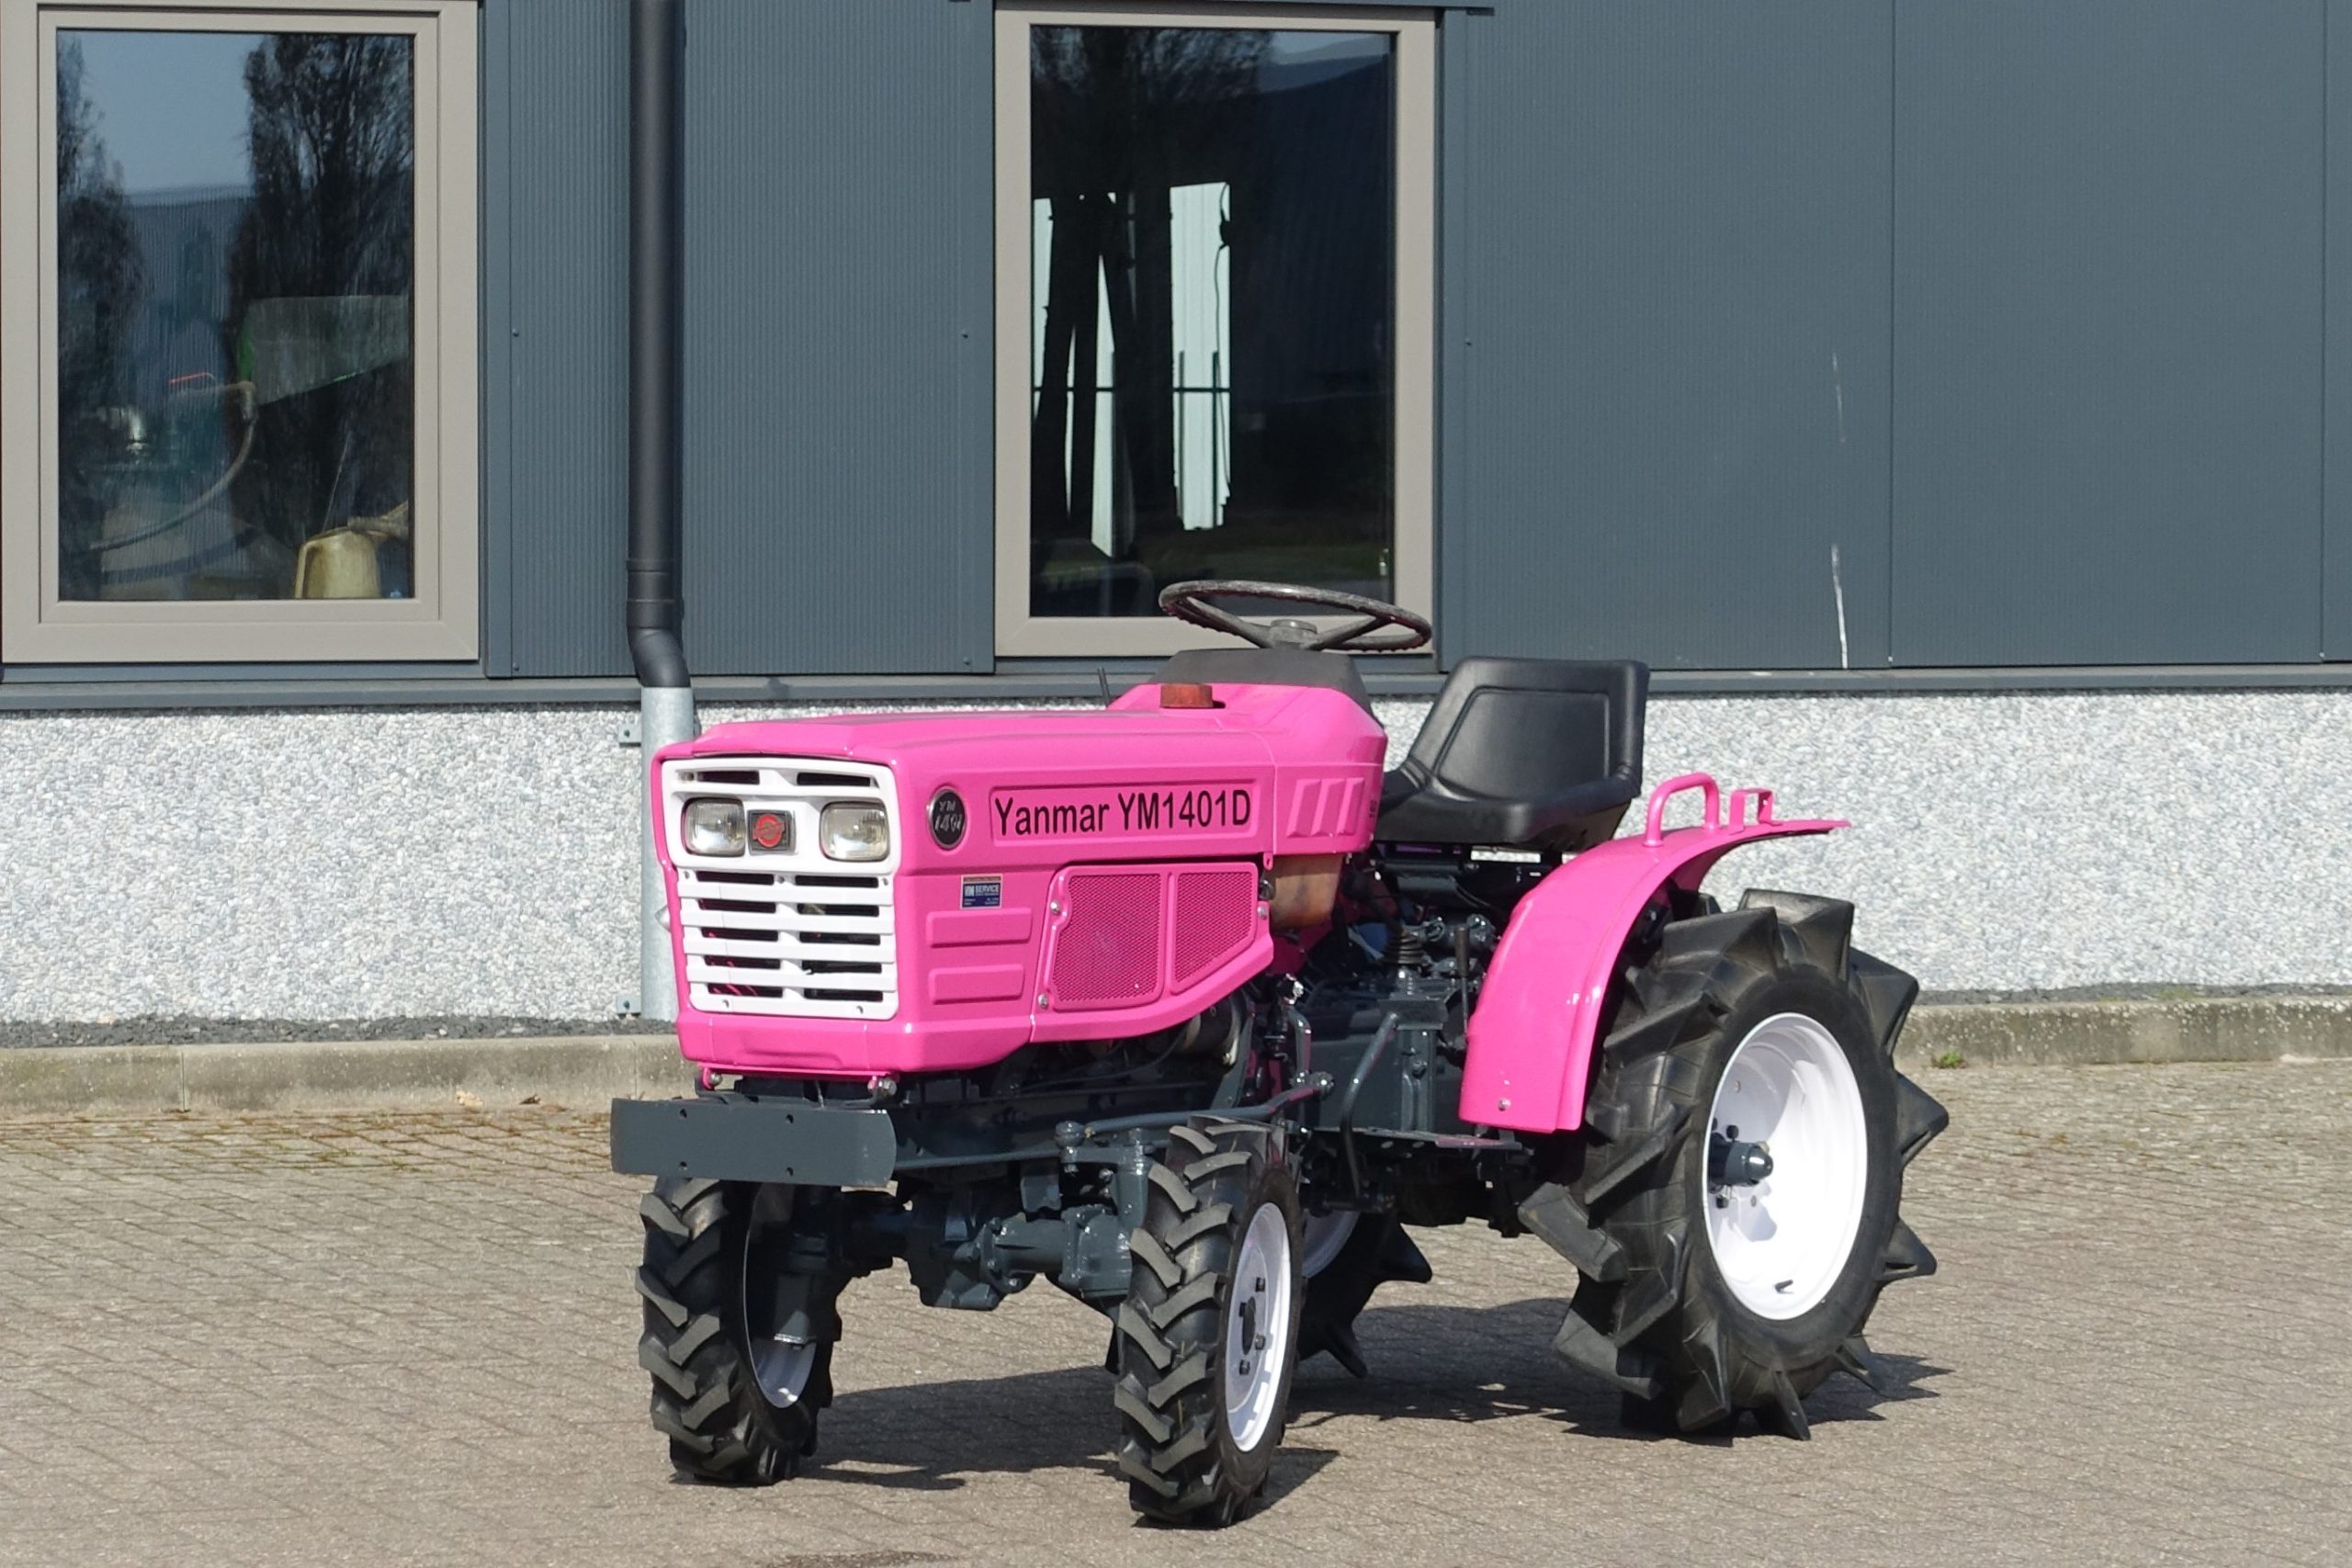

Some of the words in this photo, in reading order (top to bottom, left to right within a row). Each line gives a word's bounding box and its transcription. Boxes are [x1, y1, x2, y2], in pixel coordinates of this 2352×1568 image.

[939, 800, 956, 812] YM
[994, 797, 1110, 836] Yanmar
[1117, 789, 1250, 830] YM1401D
[934, 814, 963, 832] 1401
[975, 885, 1000, 893] SERVICE
